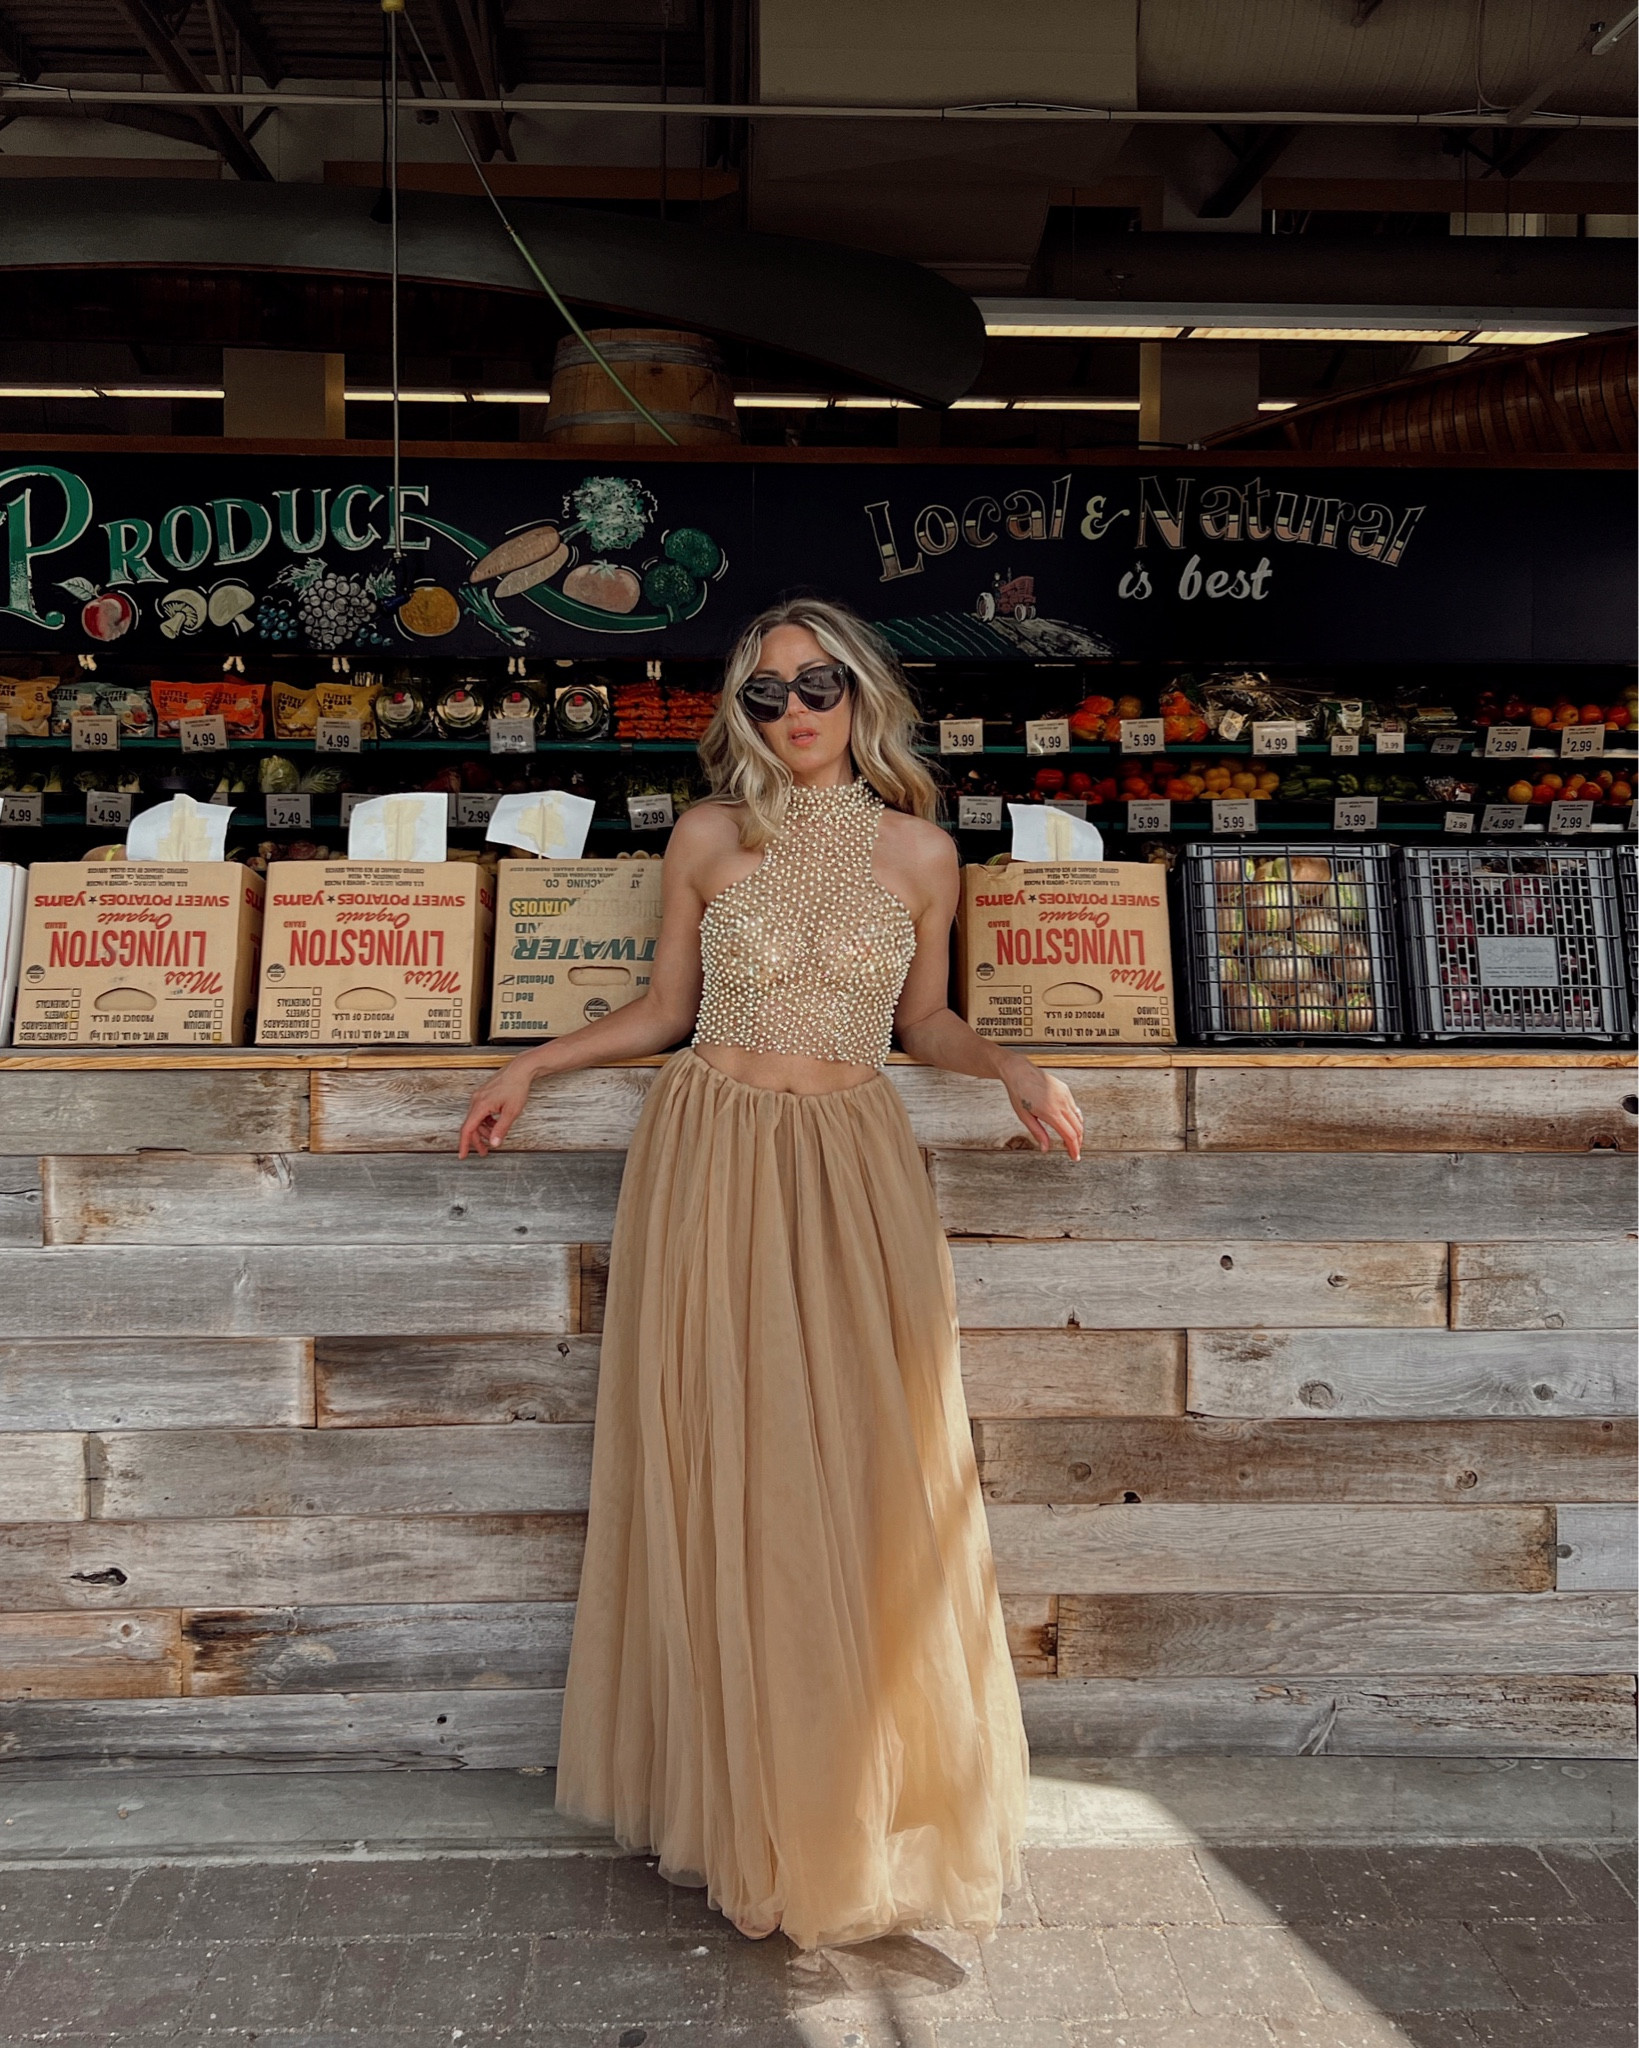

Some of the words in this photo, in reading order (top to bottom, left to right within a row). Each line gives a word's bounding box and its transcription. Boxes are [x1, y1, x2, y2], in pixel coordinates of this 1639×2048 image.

[864, 474, 1072, 582] Local
[1081, 495, 1130, 540] &
[1135, 476, 1427, 567] Natural
[1118, 560, 1152, 599] is
[1179, 555, 1272, 600] best
[543, 879, 560, 888] CO.
[34, 891, 86, 907] yams
[101, 894, 173, 906] POTATOES
[175, 894, 230, 907] SWEET
[272, 890, 324, 906] yams
[338, 893, 410, 906] POTATOES
[412, 894, 466, 907] SWEET
[976, 890, 1024, 907] yams
[1038, 893, 1110, 906] POTATOES
[1111, 895, 1160, 907] SWEET
[97, 907, 173, 929] Organic
[336, 907, 410, 929] Organic
[1038, 907, 1110, 928] Organic
[988, 920, 1010, 928] BRAND
[49, 930, 207, 967] LIVINGSTON
[289, 929, 444, 966] LIVINGSTON
[996, 929, 1145, 965] LIVINGSTON
[165, 971, 223, 994] Miss
[403, 970, 461, 993] Miss
[516, 975, 554, 984] Oriental
[1110, 969, 1165, 992] Miss
[516, 992, 534, 1002] Red
[44, 1011, 70, 1019] SWEETS
[112, 1014, 121, 1022] OF
[123, 1014, 154, 1022] PRODUCE
[188, 1010, 212, 1018] JUMBO
[286, 1010, 310, 1018] SWEETS
[352, 1013, 362, 1021] OF
[363, 1013, 394, 1021] PRODUCE
[1064, 1011, 1073, 1019] OF
[1074, 1011, 1104, 1019] PRODUCE
[500, 1020, 512, 1030] OF
[514, 1020, 548, 1030] PRODUCE
[132, 1031, 141, 1040] 40
[156, 1031, 169, 1040] NET
[372, 1030, 381, 1039] 40
[396, 1030, 410, 1039] NET
[1084, 1028, 1092, 1036] 40
[1106, 1028, 1120, 1036] NET
